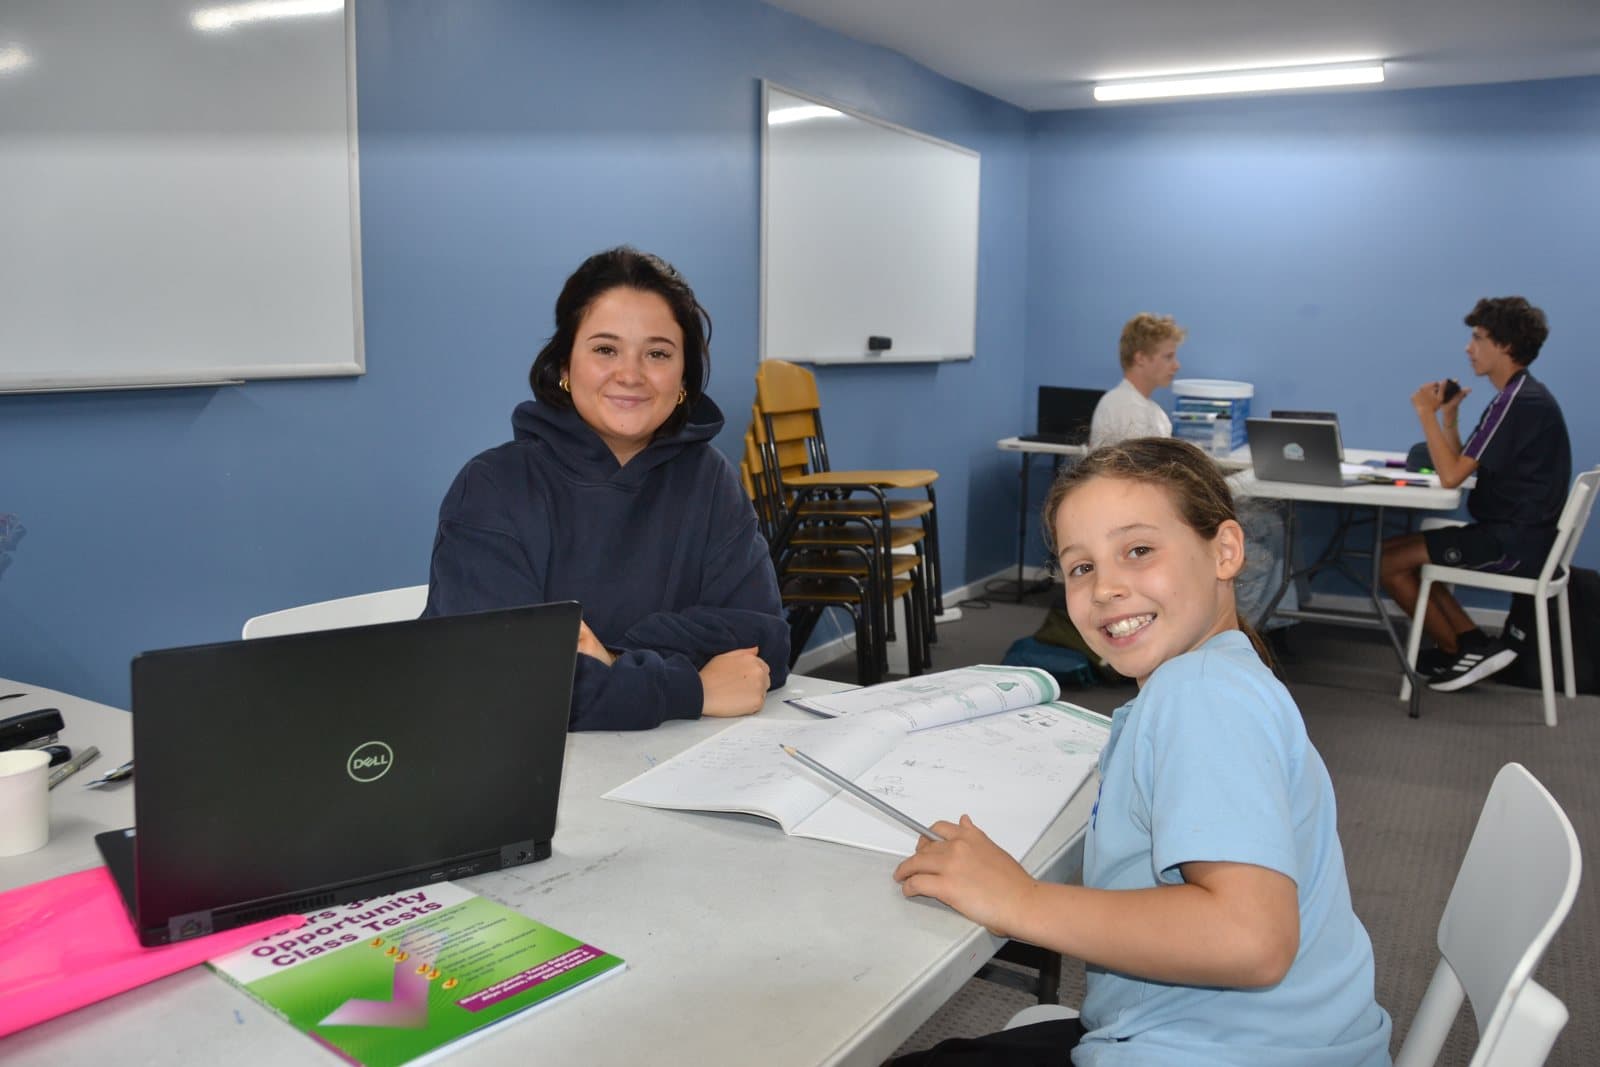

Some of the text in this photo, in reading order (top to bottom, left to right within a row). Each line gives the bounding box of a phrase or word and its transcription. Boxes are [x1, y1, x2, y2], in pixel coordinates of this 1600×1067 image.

[353, 755, 388, 769] DELL
[252, 892, 427, 957] Opportunity
[271, 933, 359, 966] Class
[361, 902, 442, 932] Tests
